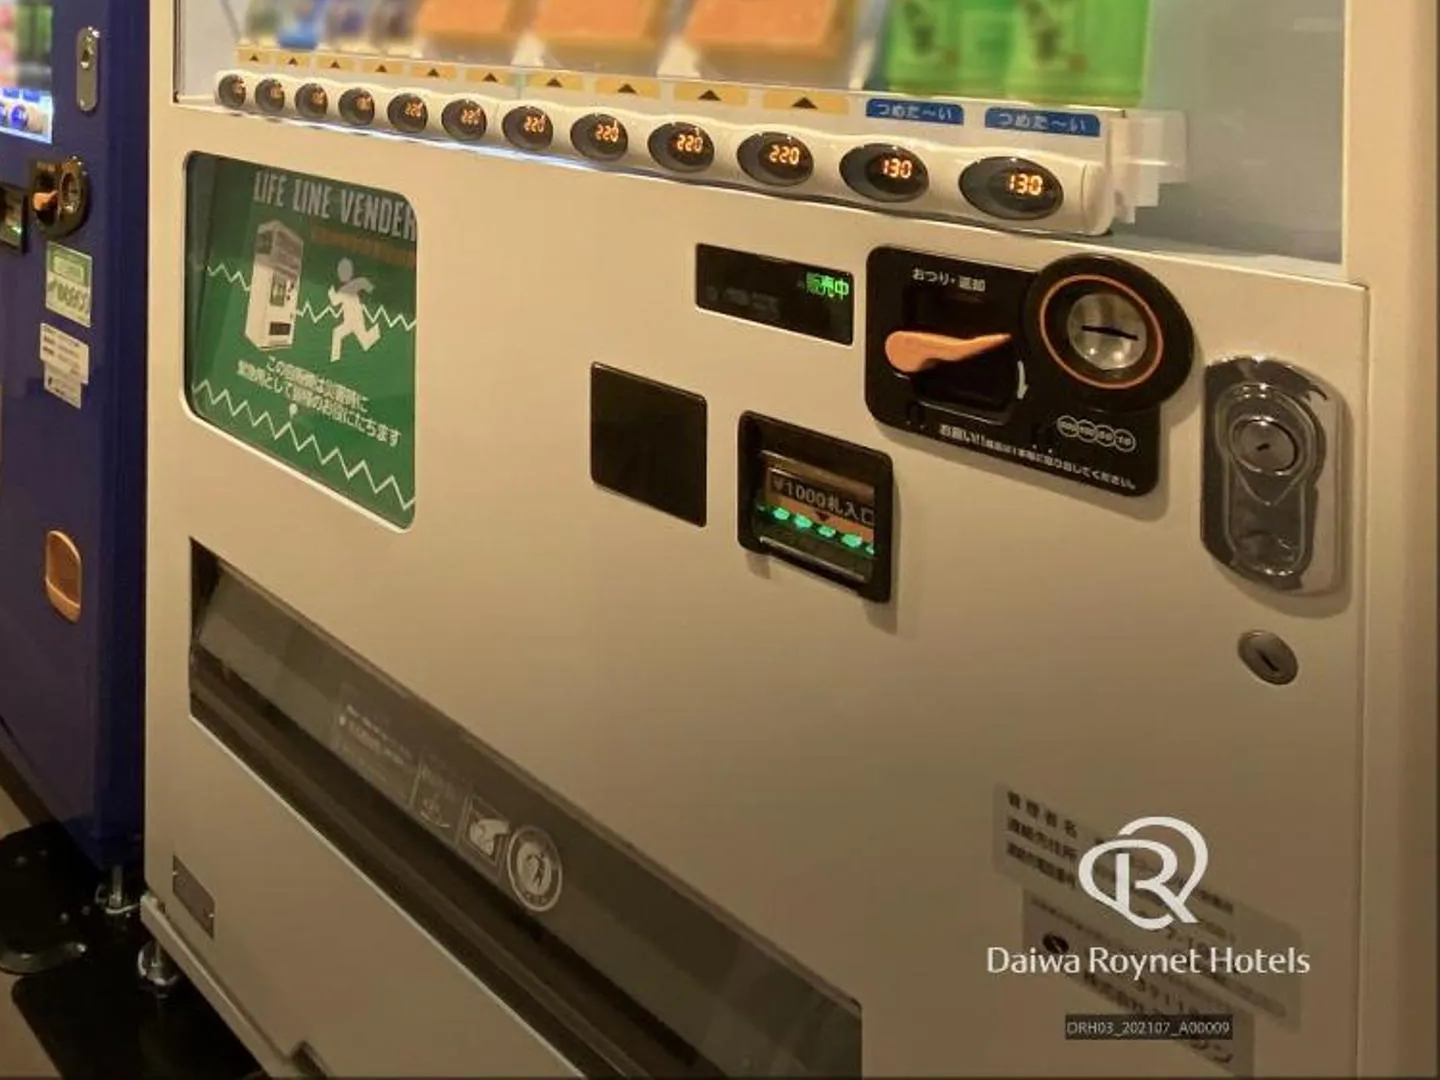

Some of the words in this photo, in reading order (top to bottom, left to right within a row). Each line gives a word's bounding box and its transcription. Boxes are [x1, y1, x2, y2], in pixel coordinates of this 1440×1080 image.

[596, 123, 620, 143] 220
[676, 133, 704, 153] 220
[769, 144, 800, 165] 220
[883, 158, 913, 179] 130
[1009, 173, 1044, 196] 130
[253, 171, 288, 208] LIFE
[292, 179, 332, 219] LINE
